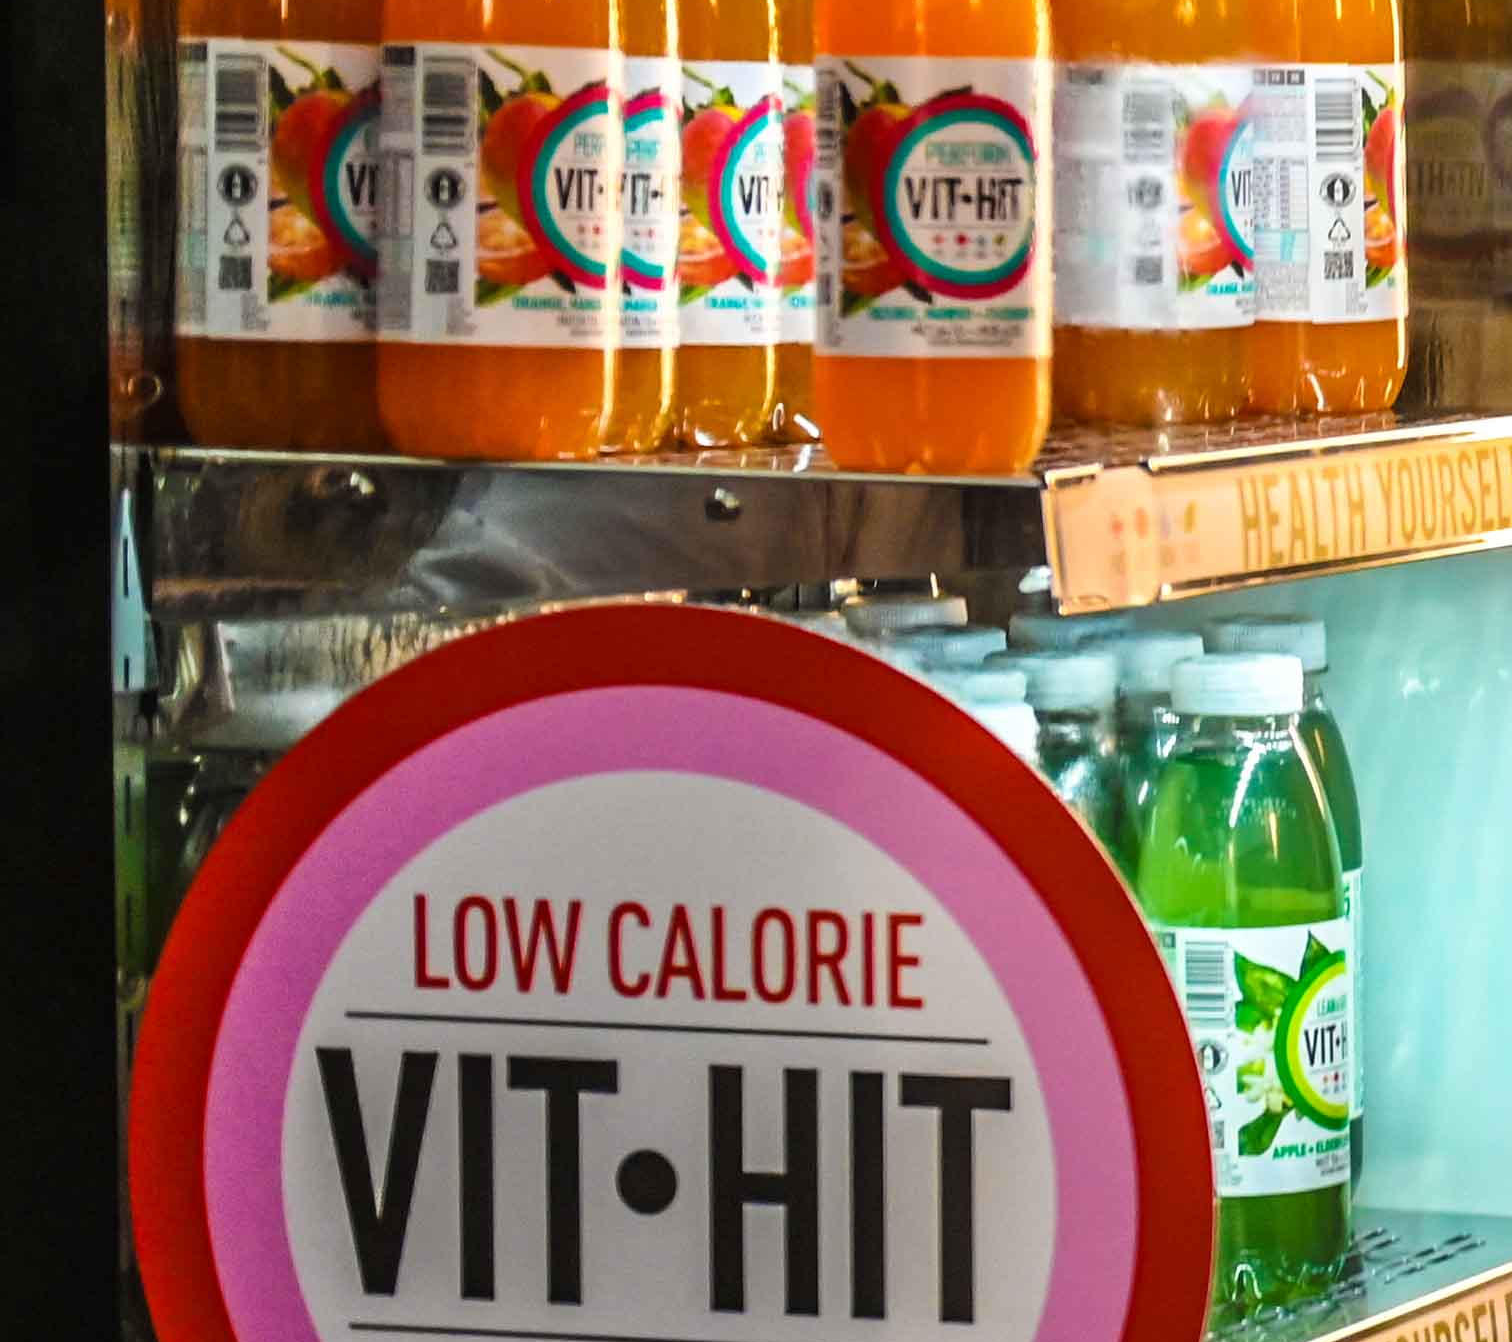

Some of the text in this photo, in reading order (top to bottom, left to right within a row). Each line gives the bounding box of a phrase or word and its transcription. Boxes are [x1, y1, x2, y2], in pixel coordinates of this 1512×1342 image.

[1235, 466, 1368, 570] HEALTH
[414, 894, 925, 1010] LOW CALORIE
